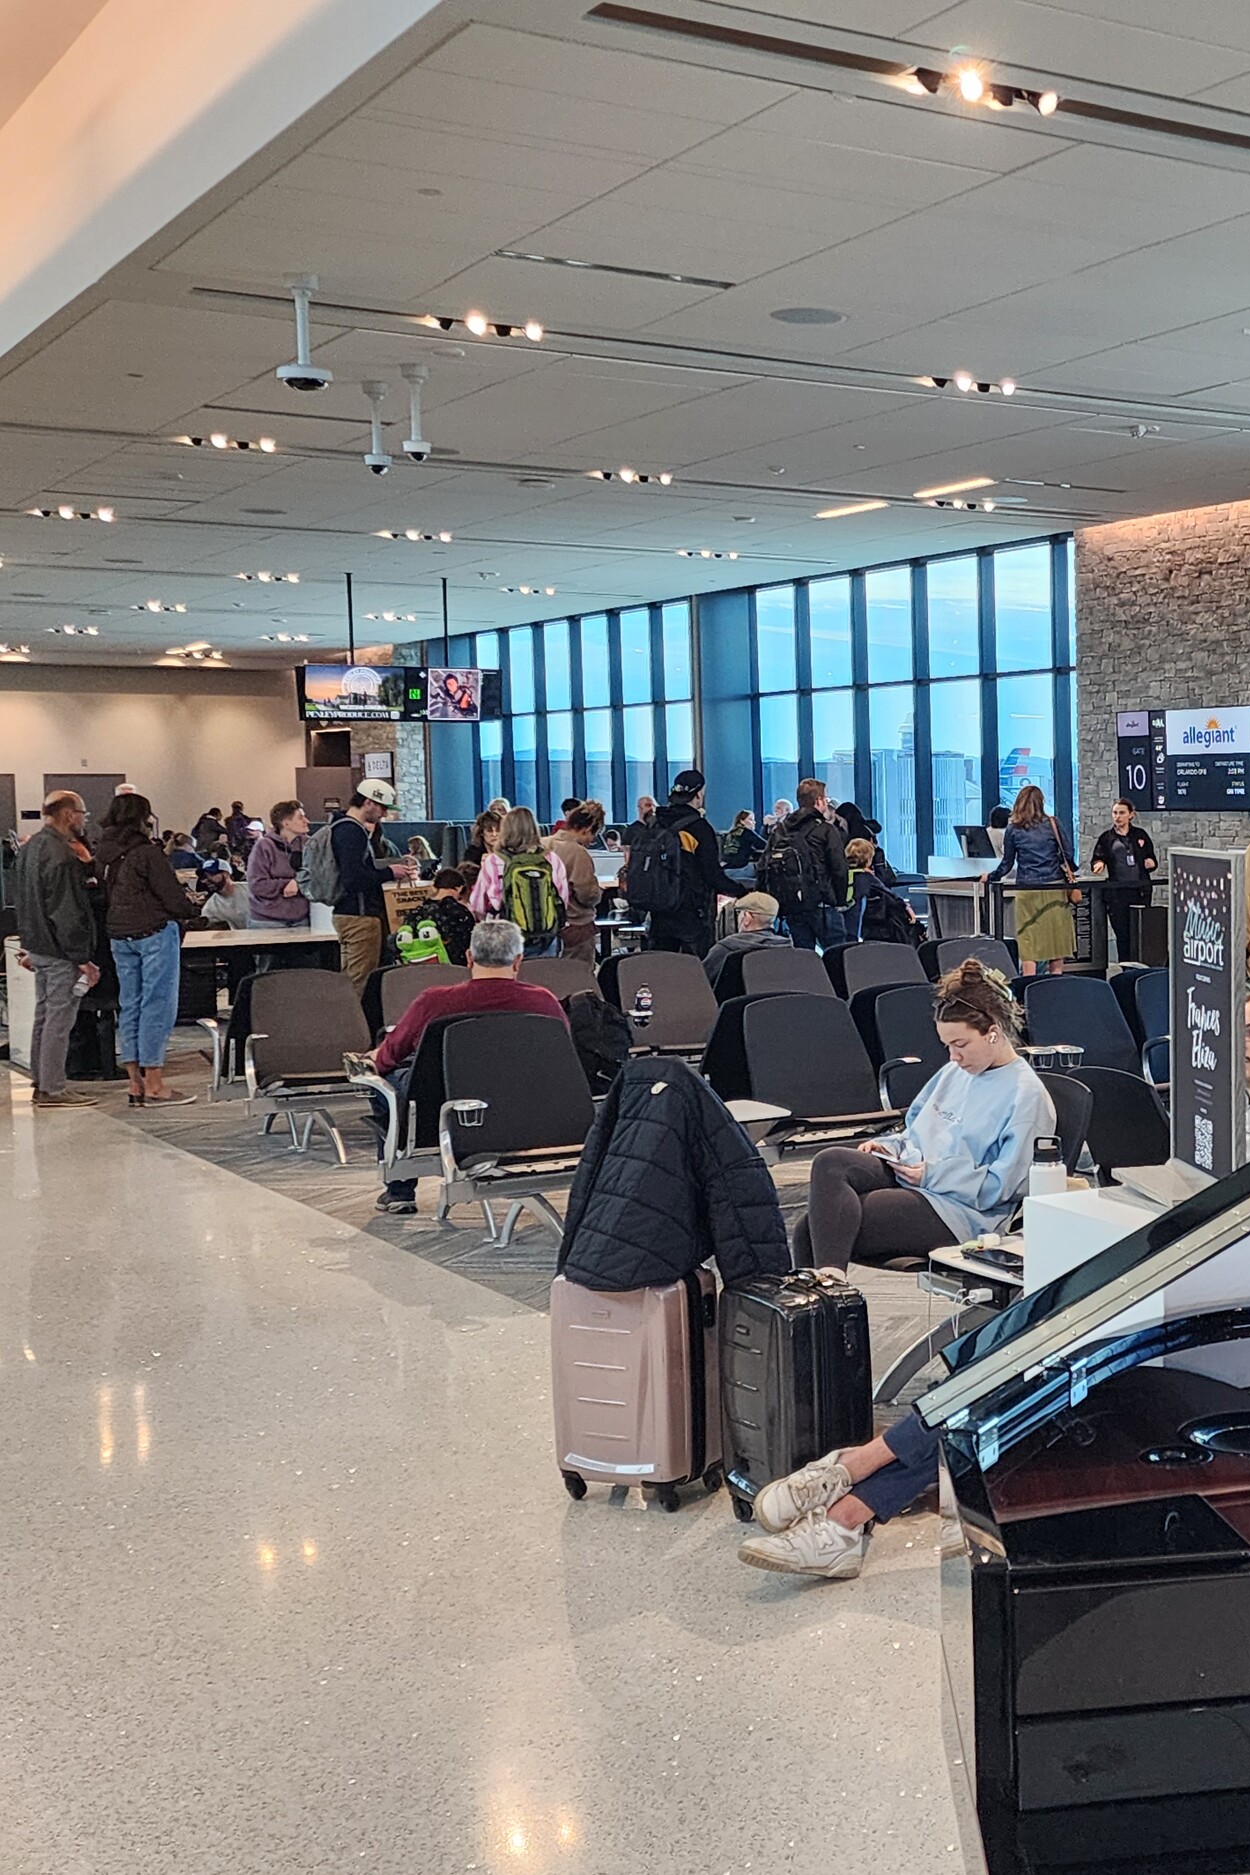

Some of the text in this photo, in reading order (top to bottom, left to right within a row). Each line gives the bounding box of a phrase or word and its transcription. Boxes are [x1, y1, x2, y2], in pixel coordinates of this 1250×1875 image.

[1183, 727, 1235, 748] allegiant
[1126, 765, 1146, 790] 10
[1183, 935, 1224, 967] airport
